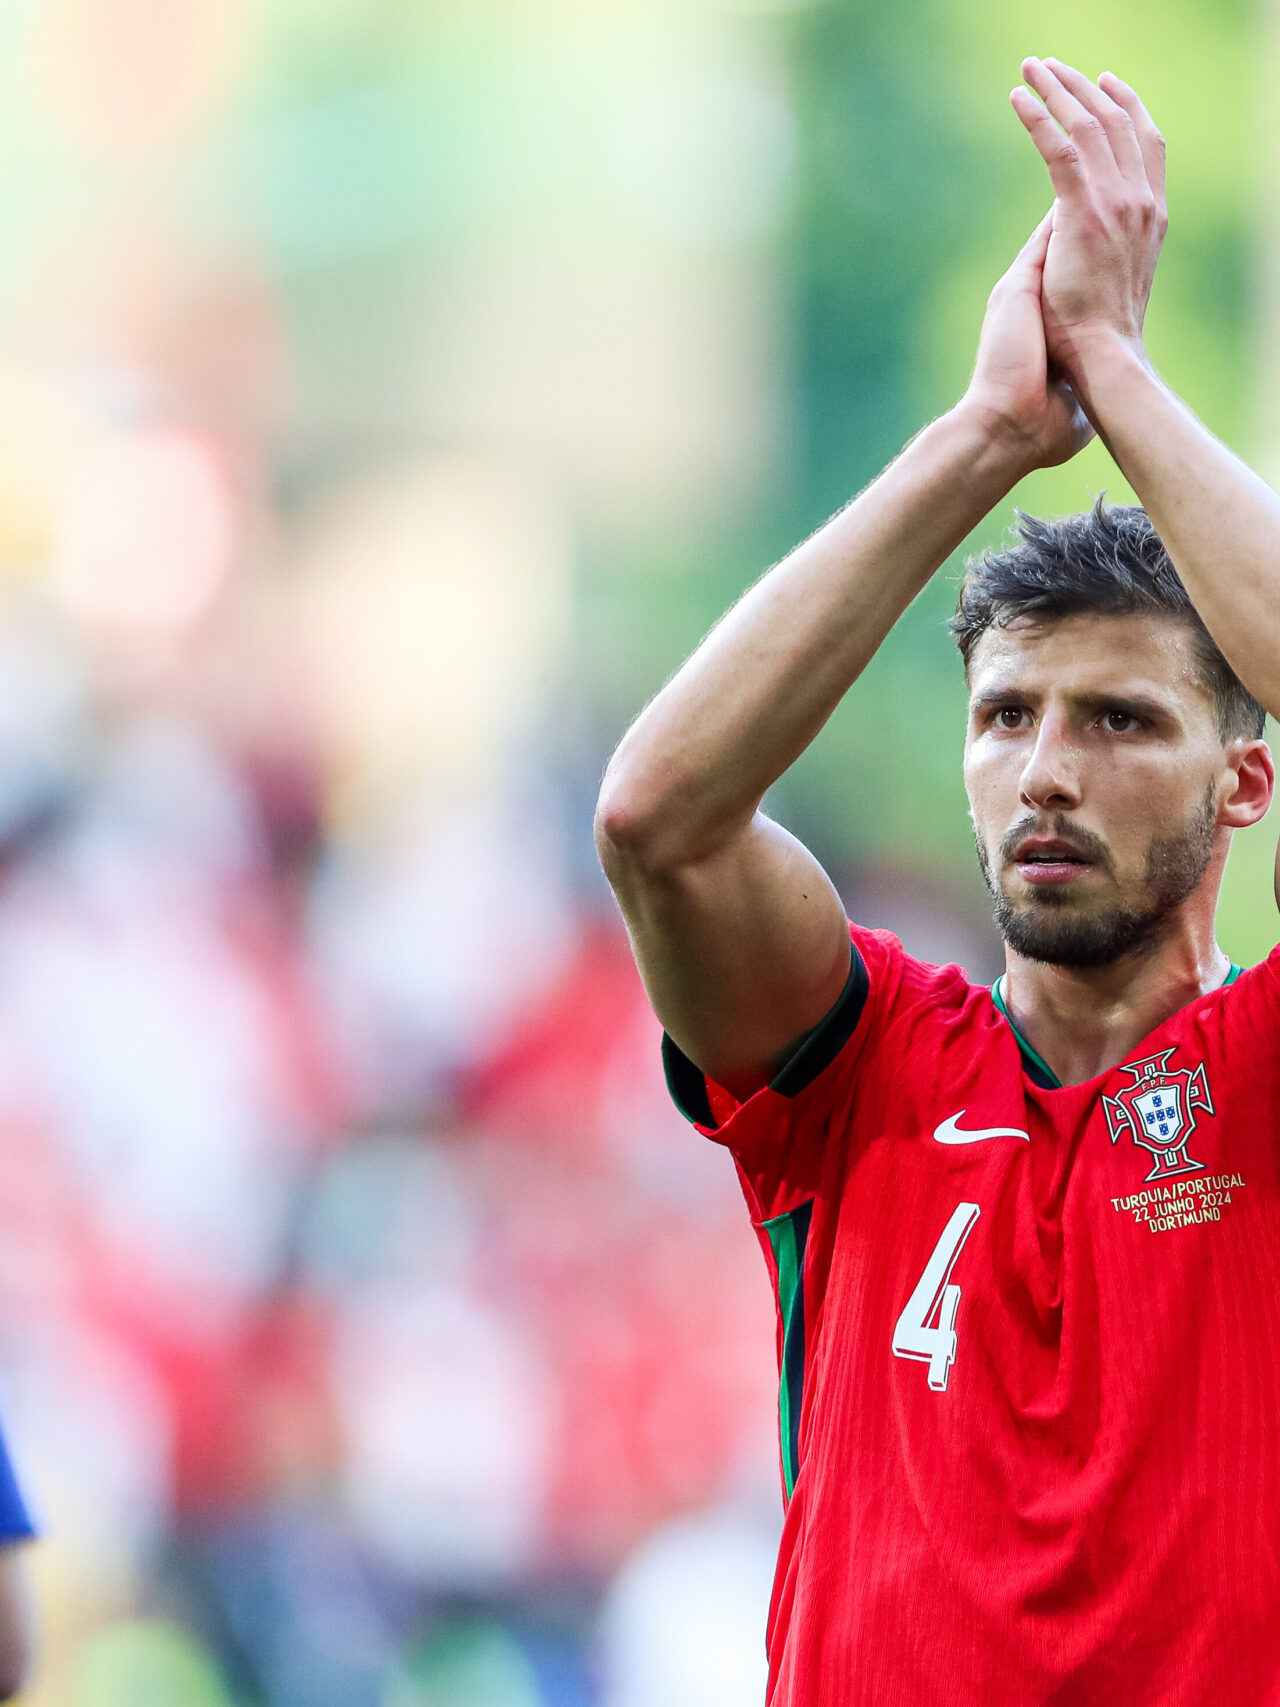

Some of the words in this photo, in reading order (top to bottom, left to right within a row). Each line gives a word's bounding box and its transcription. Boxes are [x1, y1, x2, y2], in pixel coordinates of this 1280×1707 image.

[1131, 1207, 1150, 1223] 22
[1154, 1197, 1195, 1218] JUNHO
[1198, 1191, 1232, 1209] 2024
[1148, 1207, 1221, 1234] DORTMUND
[892, 1202, 981, 1391] 4
